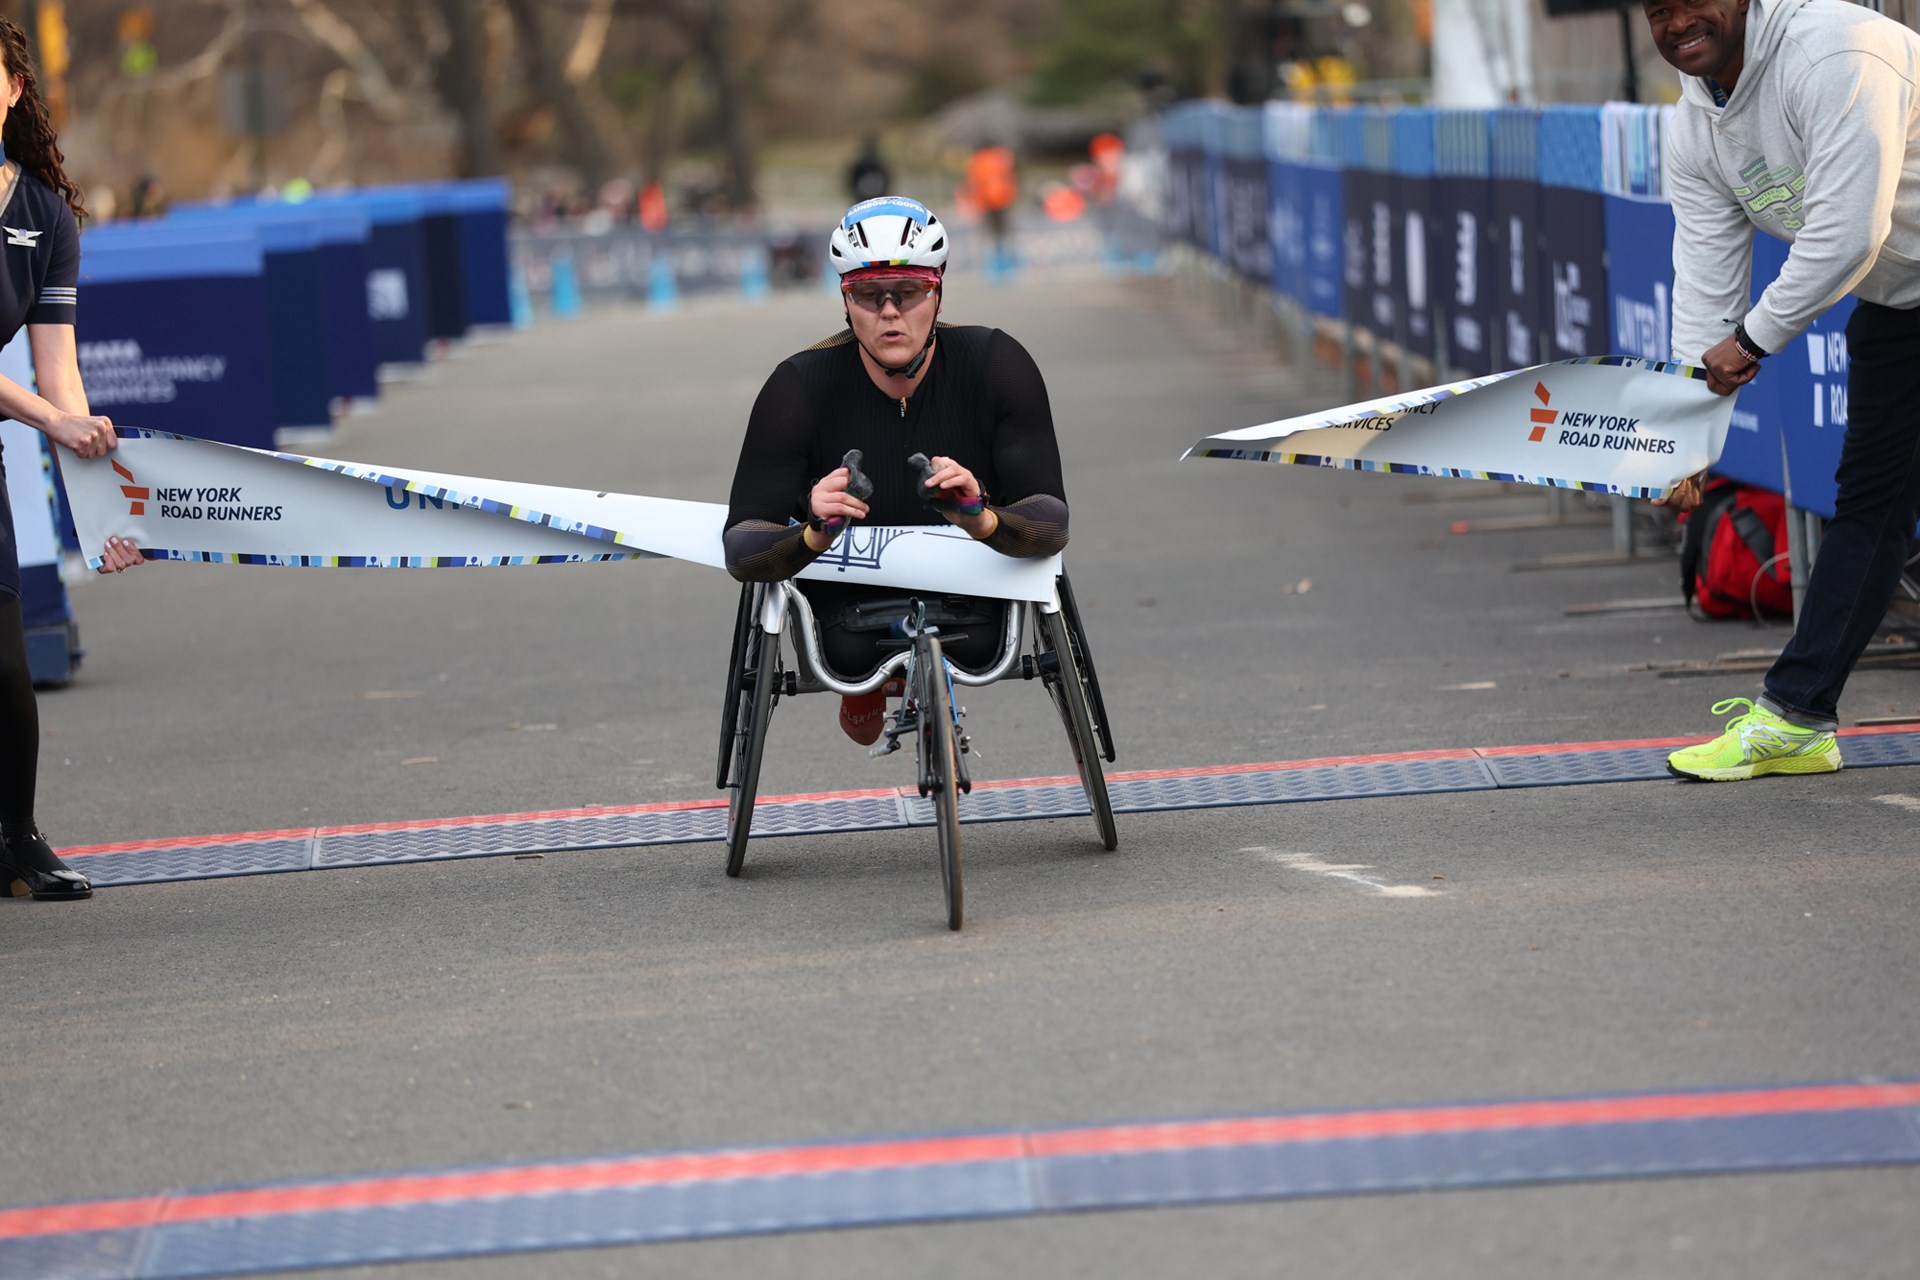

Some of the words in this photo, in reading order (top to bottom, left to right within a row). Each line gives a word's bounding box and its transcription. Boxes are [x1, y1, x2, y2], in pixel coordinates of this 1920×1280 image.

[1830, 383, 1848, 426] ROA
[1561, 411, 1598, 429] NEW
[1598, 415, 1641, 434] YORK
[1558, 430, 1600, 448] ROAD
[1602, 434, 1676, 455] RUNNERS
[156, 487, 193, 502] NEW
[196, 487, 242, 503] YORK
[161, 504, 203, 520] ROAD
[206, 505, 283, 521] RUNNERS
